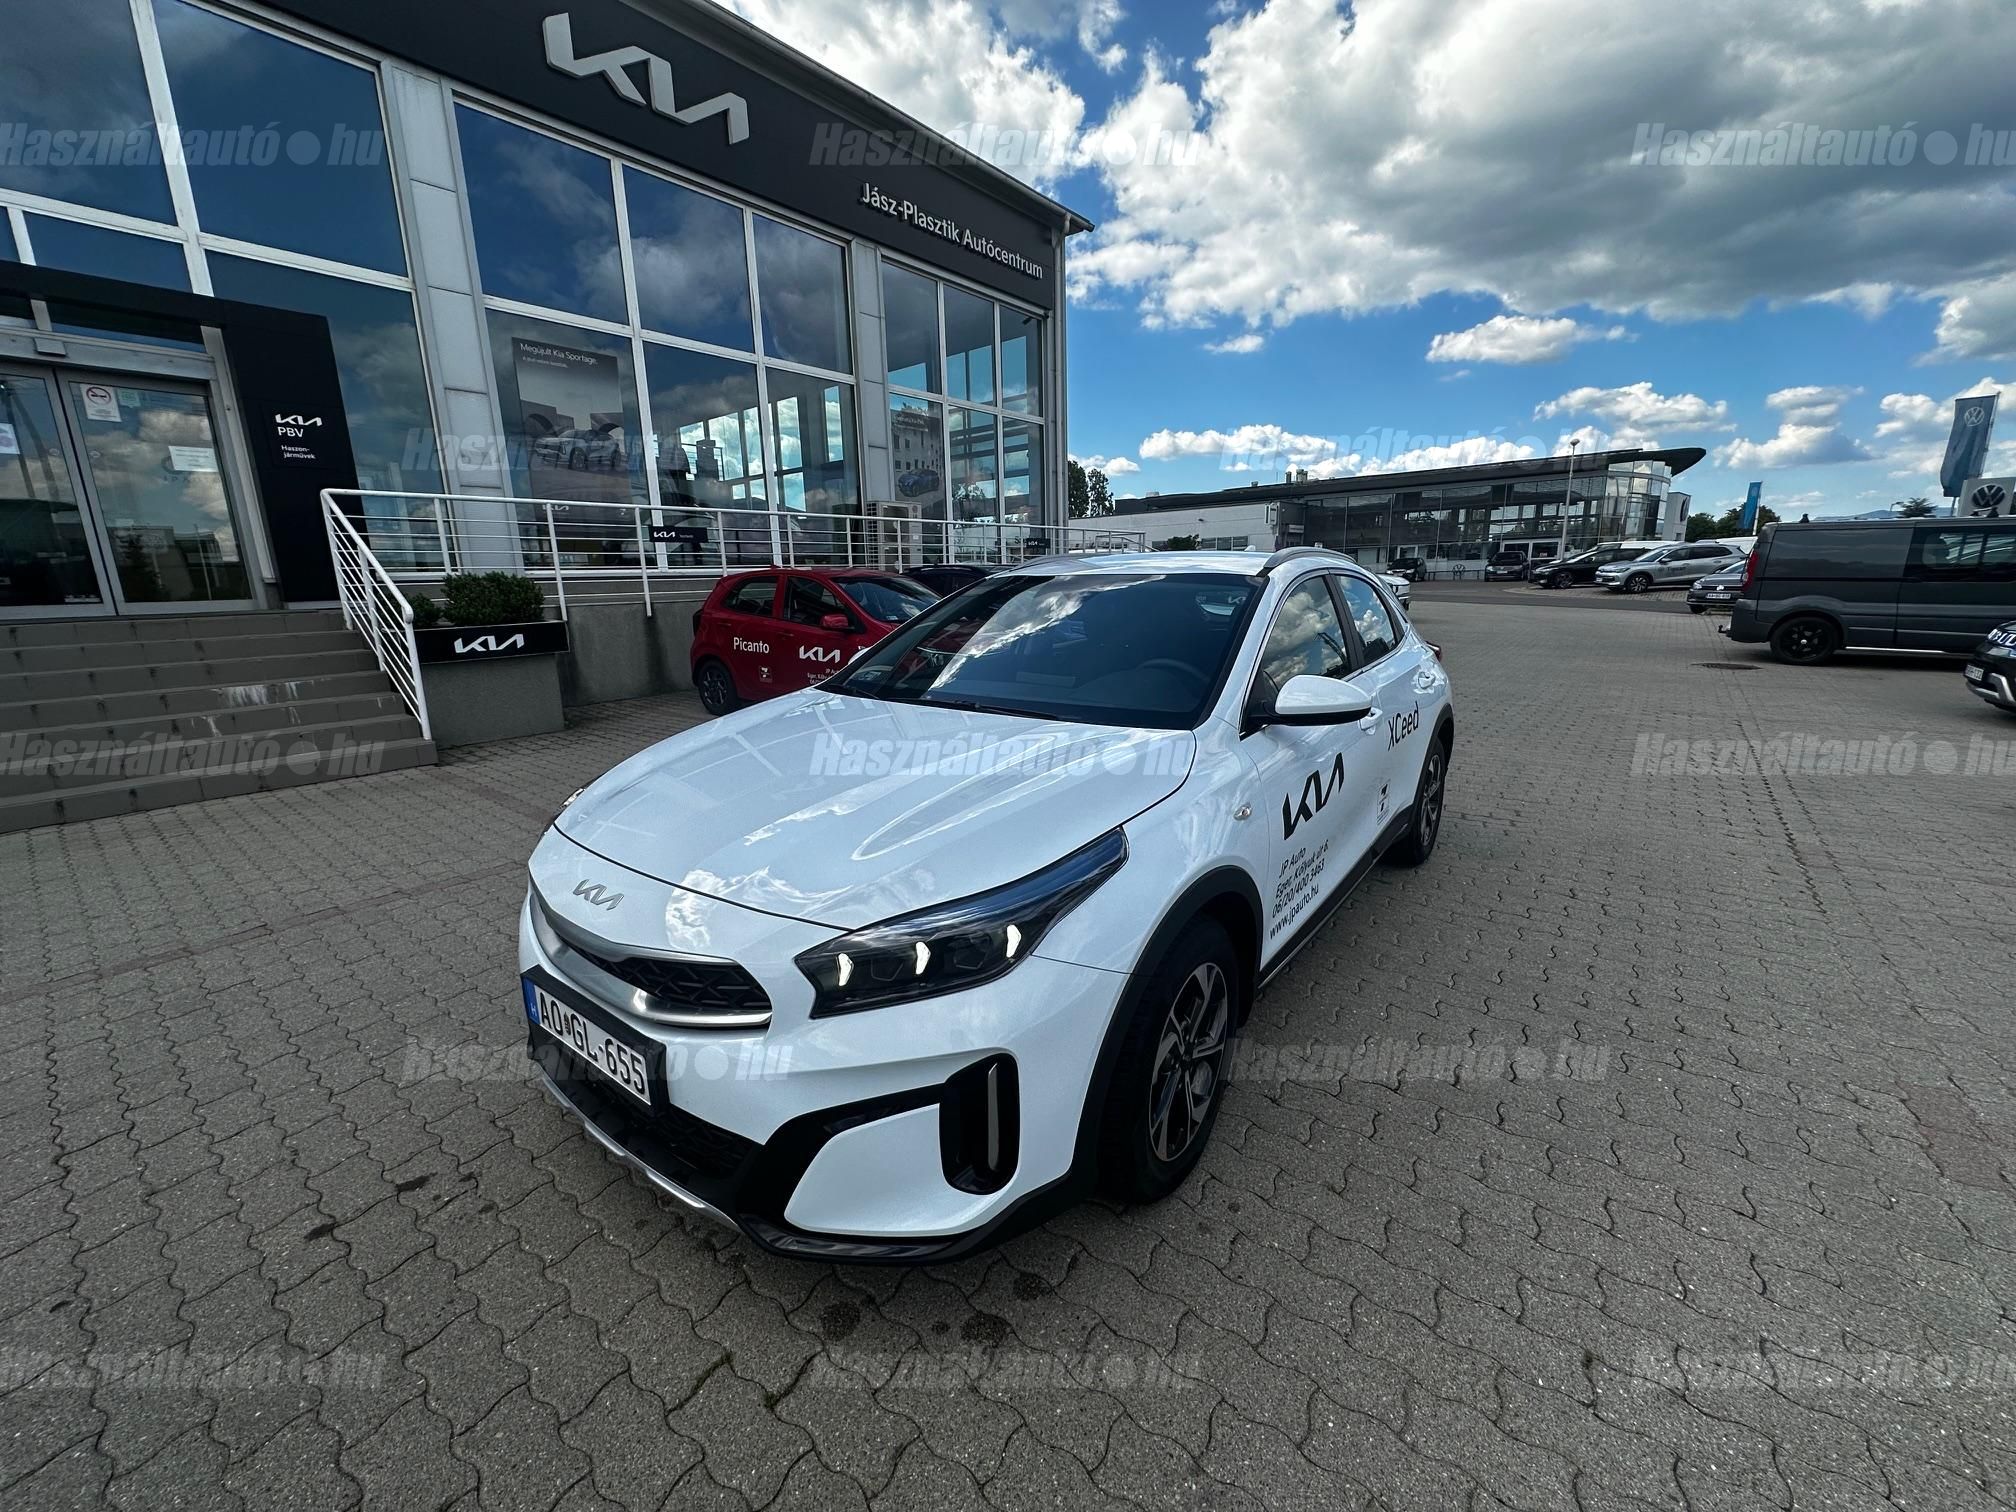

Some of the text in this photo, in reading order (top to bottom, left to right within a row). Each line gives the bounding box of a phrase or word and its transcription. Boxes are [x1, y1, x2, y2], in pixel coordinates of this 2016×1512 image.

[542, 12, 749, 145] KIA
[862, 182, 1043, 279] Jász-Plasztik Autócentrum
[553, 349, 564, 359] Kia
[275, 413, 322, 427] KIA
[277, 426, 304, 438] PBV
[454, 633, 524, 653] KIA
[733, 636, 770, 654] Picanto
[799, 645, 841, 664] KIA
[1387, 701, 1419, 752] XCeed
[1282, 752, 1345, 840] KIA
[1279, 847, 1306, 879] JP Auto
[573, 879, 625, 911] KIA
[1269, 884, 1319, 940] www.jpauto.hu
